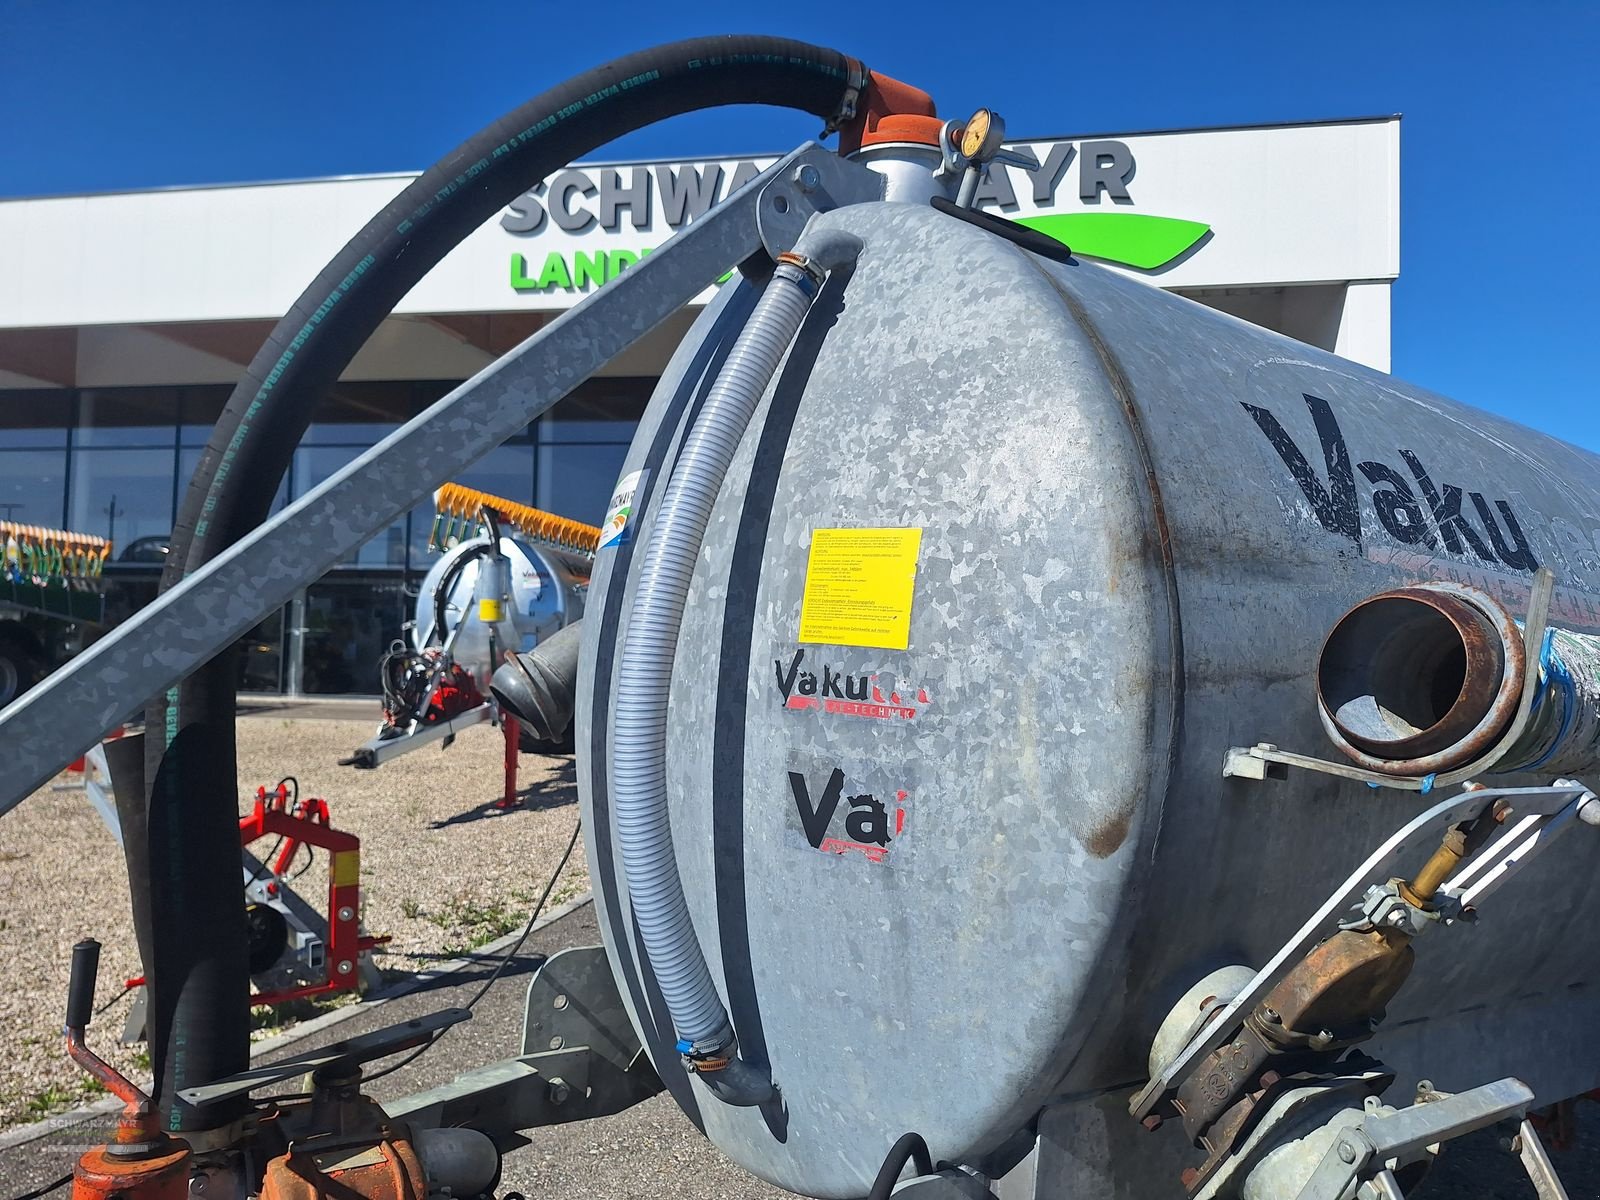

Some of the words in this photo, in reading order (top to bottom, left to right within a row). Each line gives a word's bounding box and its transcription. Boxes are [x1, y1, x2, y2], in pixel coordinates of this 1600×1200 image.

[620, 69, 660, 90] RUBBER
[584, 84, 620, 105] WATER
[556, 101, 584, 120] HOSE
[492, 144, 510, 159] bar
[464, 158, 490, 178] MADE
[338, 253, 376, 291] RUBBER
[310, 290, 343, 324] WATER
[289, 323, 315, 351] HOSE
[229, 424, 249, 450] MADE
[212, 460, 231, 489] ITALY
[775, 649, 870, 707] Vaku
